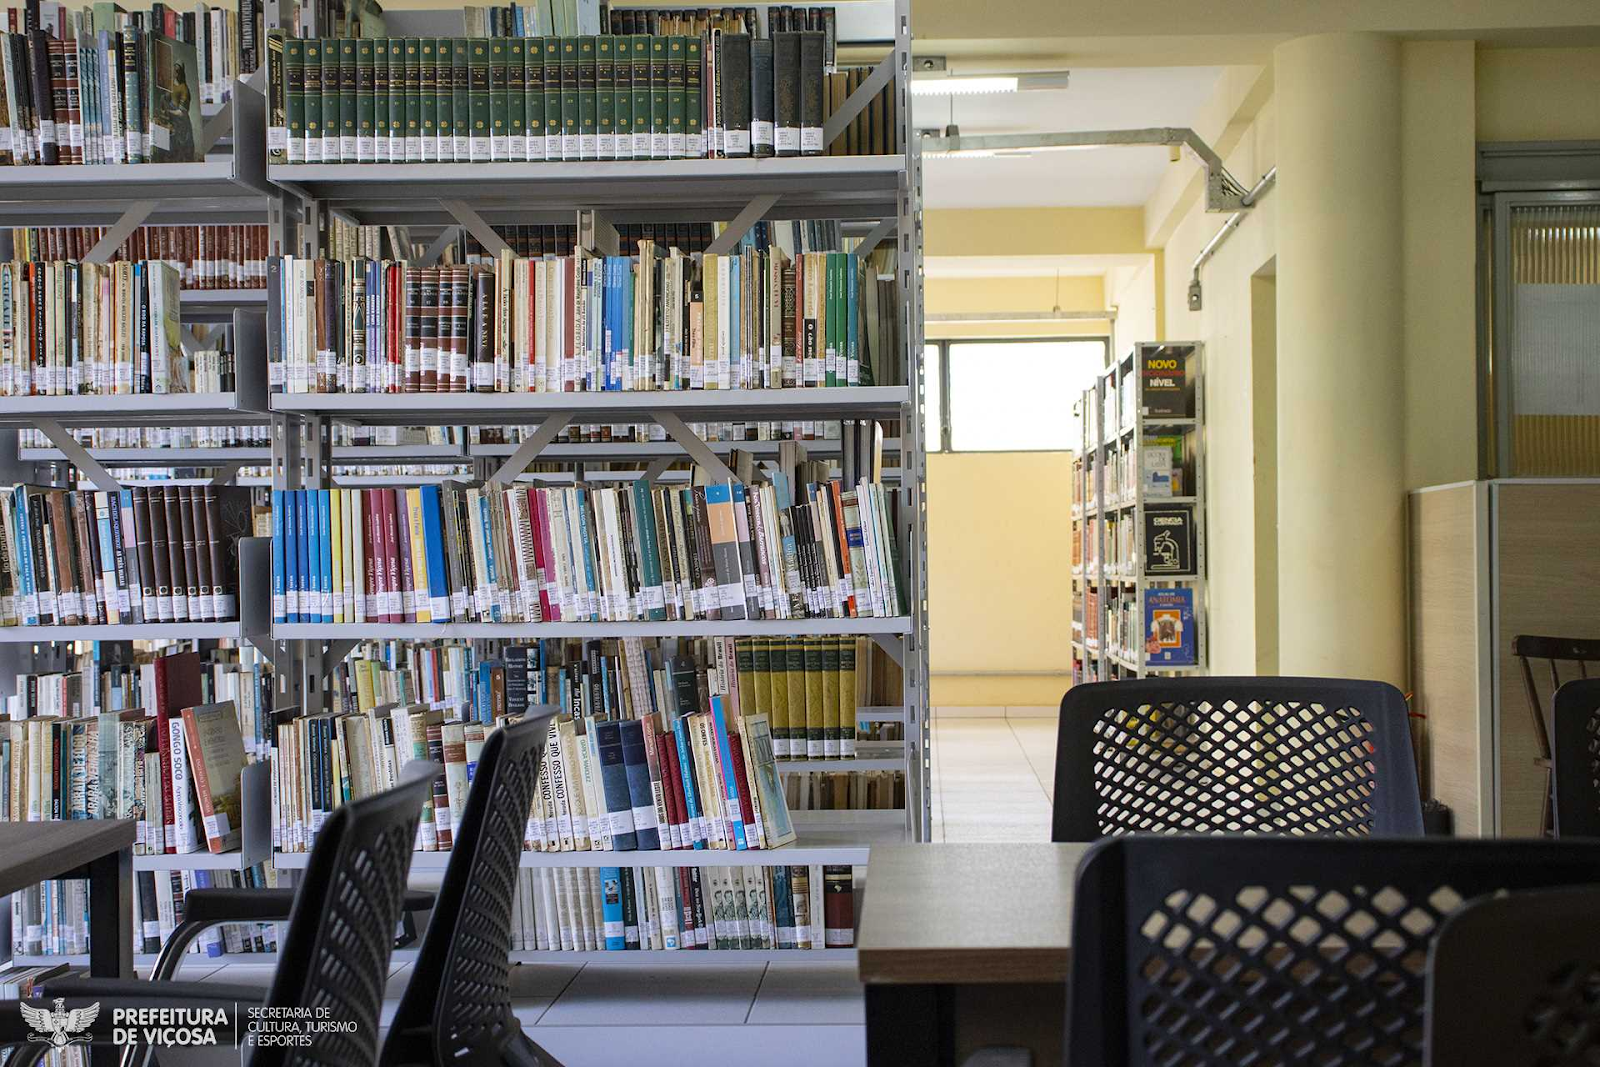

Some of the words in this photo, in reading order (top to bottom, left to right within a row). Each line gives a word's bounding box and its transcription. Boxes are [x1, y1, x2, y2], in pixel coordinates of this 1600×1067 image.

[1148, 360, 1177, 369] NOVO
[1150, 377, 1175, 387] NÍVEL
[172, 722, 182, 755] GONGO
[549, 742, 560, 757] QUE
[87, 730, 99, 782] VERMELHA
[175, 757, 183, 780] SOCO
[540, 762, 551, 800] CONFESSO
[552, 761, 564, 799] CONFESSO
[88, 784, 99, 814] ARARA
